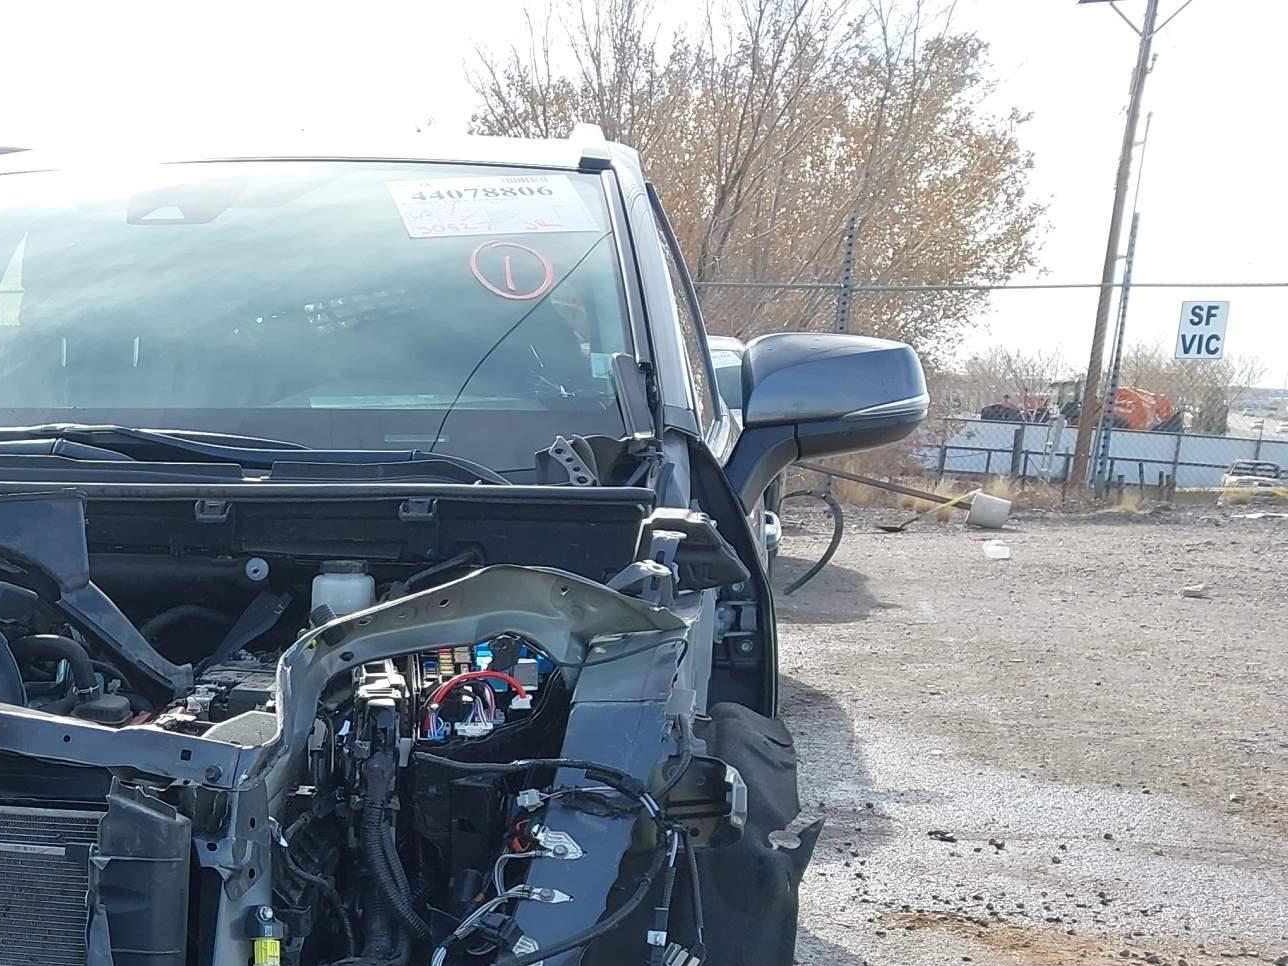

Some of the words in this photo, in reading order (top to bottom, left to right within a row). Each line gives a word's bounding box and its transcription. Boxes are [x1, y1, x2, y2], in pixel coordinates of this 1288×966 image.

[410, 185, 553, 201] 44078806
[503, 254, 517, 292] 1
[1189, 304, 1220, 327] SF
[1180, 333, 1222, 356] VIC
